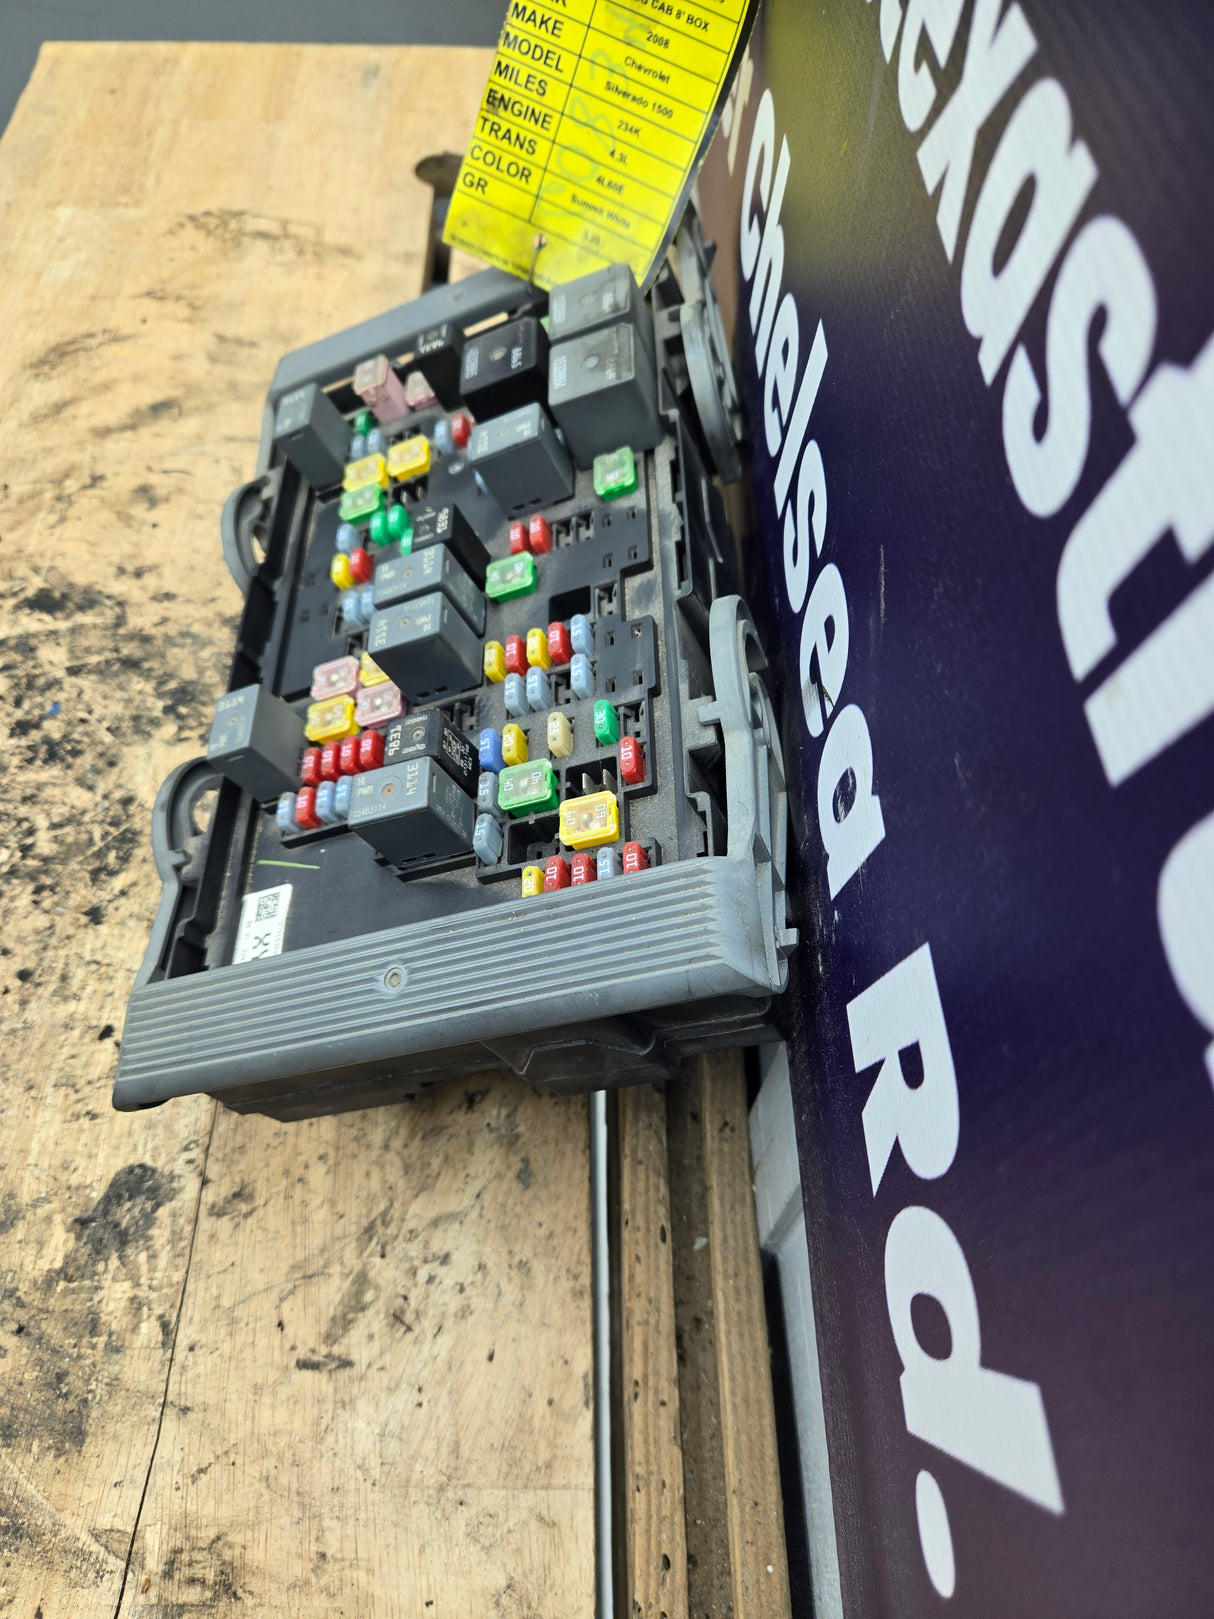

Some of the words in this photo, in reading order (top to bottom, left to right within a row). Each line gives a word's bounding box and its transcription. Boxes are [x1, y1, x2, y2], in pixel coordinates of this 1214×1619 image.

[511, 1, 565, 38] MAKE
[650, 0, 674, 16] CAB
[686, 14, 710, 32] BOX
[646, 31, 670, 49] 2008
[502, 30, 564, 73] MODEL
[623, 56, 671, 84] Chevrolet
[494, 60, 548, 97] MILES
[604, 80, 650, 109] Silverado
[650, 101, 674, 120] 1500
[486, 88, 553, 132] ENGINE
[479, 115, 538, 156] TRANS
[470, 144, 532, 185] COLOR
[462, 172, 488, 196] GR
[550, 630, 560, 644] 10
[571, 623, 582, 636] 15
[506, 642, 517, 657] 10
[572, 662, 582, 676] 15
[506, 680, 516, 695] 15
[527, 674, 538, 688] 15
[596, 709, 606, 724] 30
[550, 720, 559, 735] 25
[360, 738, 372, 752] 10
[479, 738, 490, 752] 15
[621, 745, 632, 760] 10
[322, 750, 333, 764] 10
[504, 778, 514, 793] 40
[531, 771, 542, 785] 40
[318, 790, 328, 802] 15
[336, 784, 347, 797] 15
[357, 785, 374, 797] PWR
[479, 782, 490, 797] 15
[565, 810, 576, 826] 60
[596, 803, 606, 819] 60
[476, 823, 486, 836] 15
[740, 88, 887, 898] Chelsea
[846, 941, 1065, 1598] Rd.
[599, 859, 610, 875] 15
[626, 852, 638, 867] 10
[546, 866, 557, 880] 10
[573, 865, 584, 882] 10
[524, 878, 535, 893] 20
